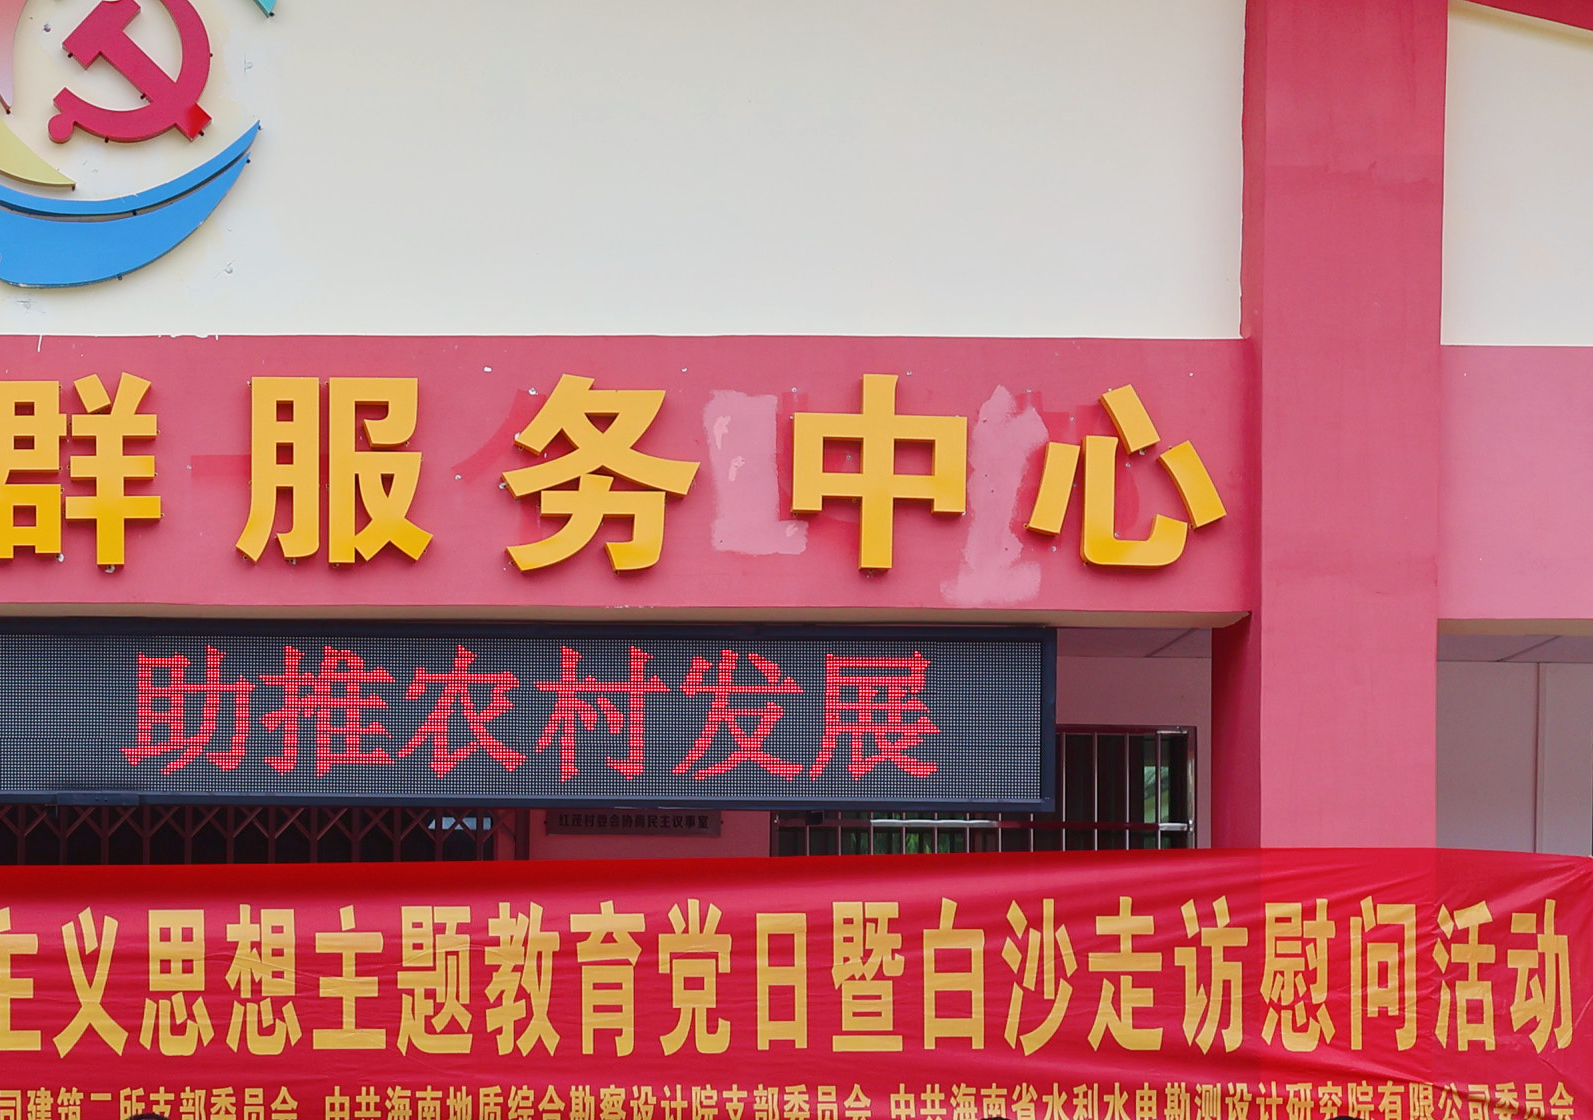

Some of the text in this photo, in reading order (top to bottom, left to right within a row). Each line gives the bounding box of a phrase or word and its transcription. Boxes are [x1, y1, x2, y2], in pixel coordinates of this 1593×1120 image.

[121, 643, 940, 781] 助推农村发展
